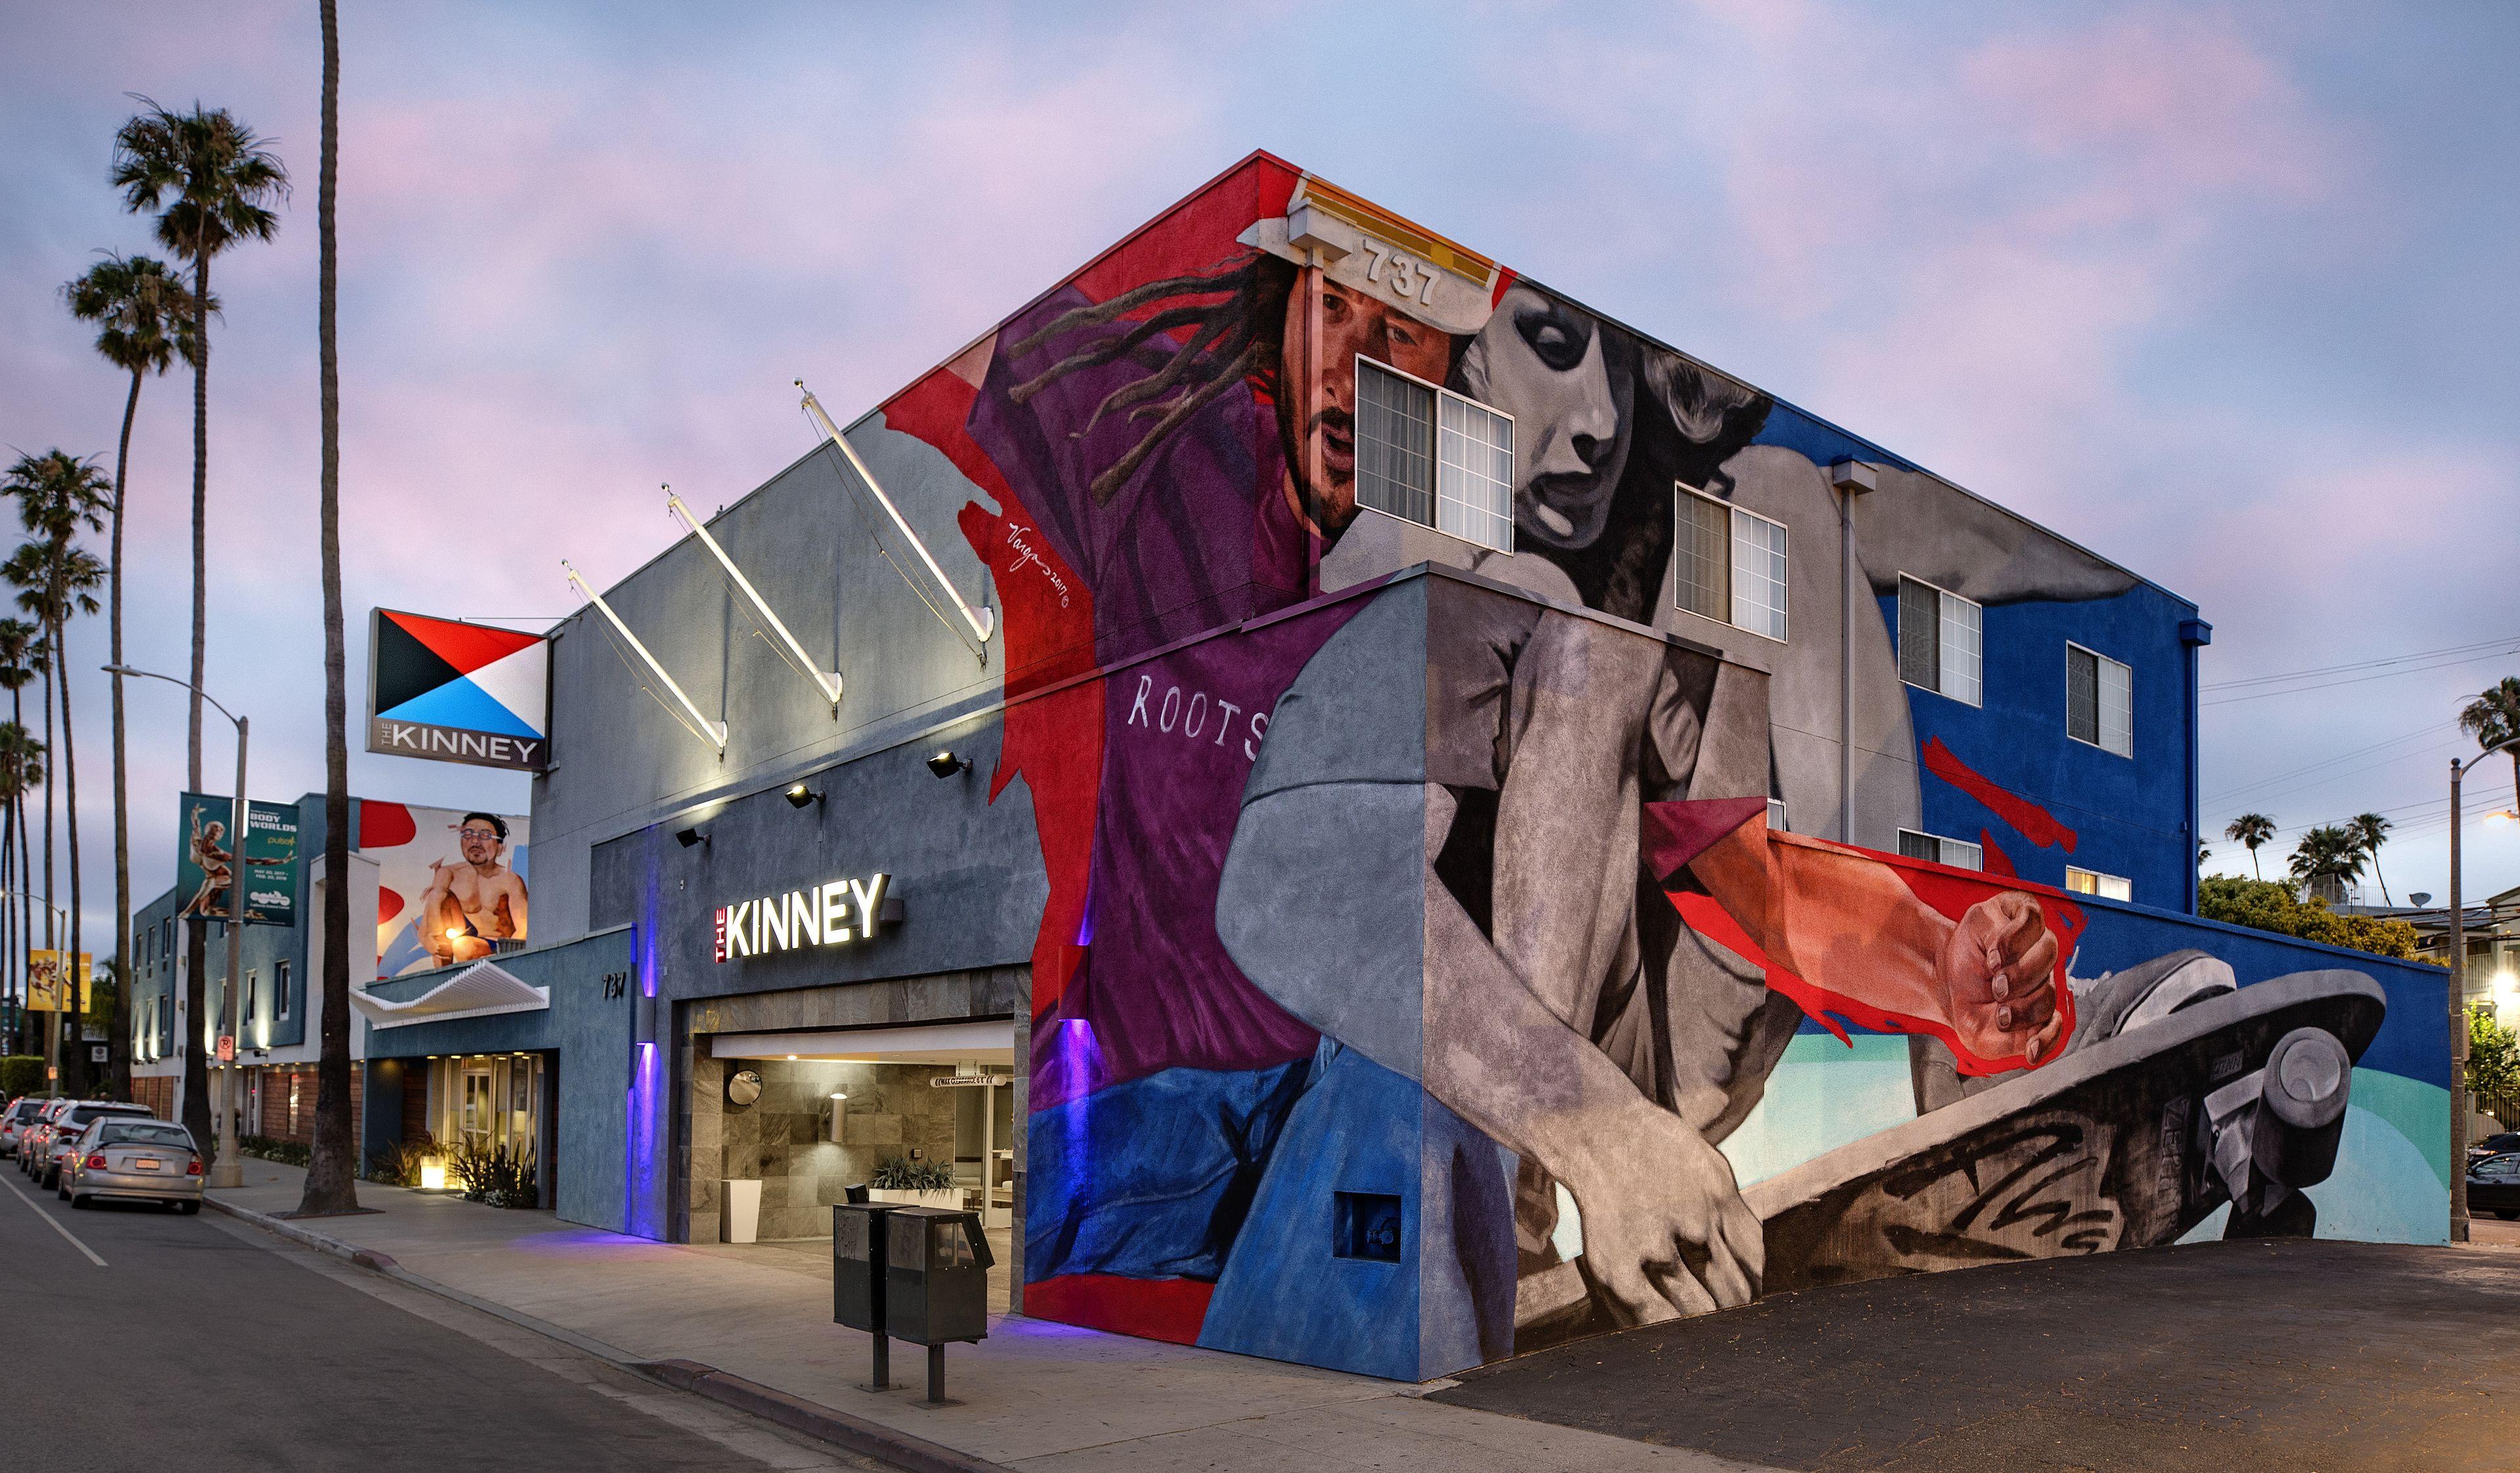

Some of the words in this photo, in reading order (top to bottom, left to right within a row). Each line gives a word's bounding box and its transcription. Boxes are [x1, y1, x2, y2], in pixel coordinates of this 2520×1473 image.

[1363, 238, 1440, 306] 737
[1051, 571, 1068, 596] 2017
[1127, 675, 1269, 762] ROOTS
[382, 722, 392, 745] THE
[393, 724, 537, 762] KINNEY
[249, 812, 281, 823] BODY
[249, 820, 297, 833] WORLDS
[715, 907, 726, 963] THE
[726, 873, 886, 959] KINNEY
[602, 971, 627, 999] 737
[950, 1076, 976, 1085] CLEARANCE
